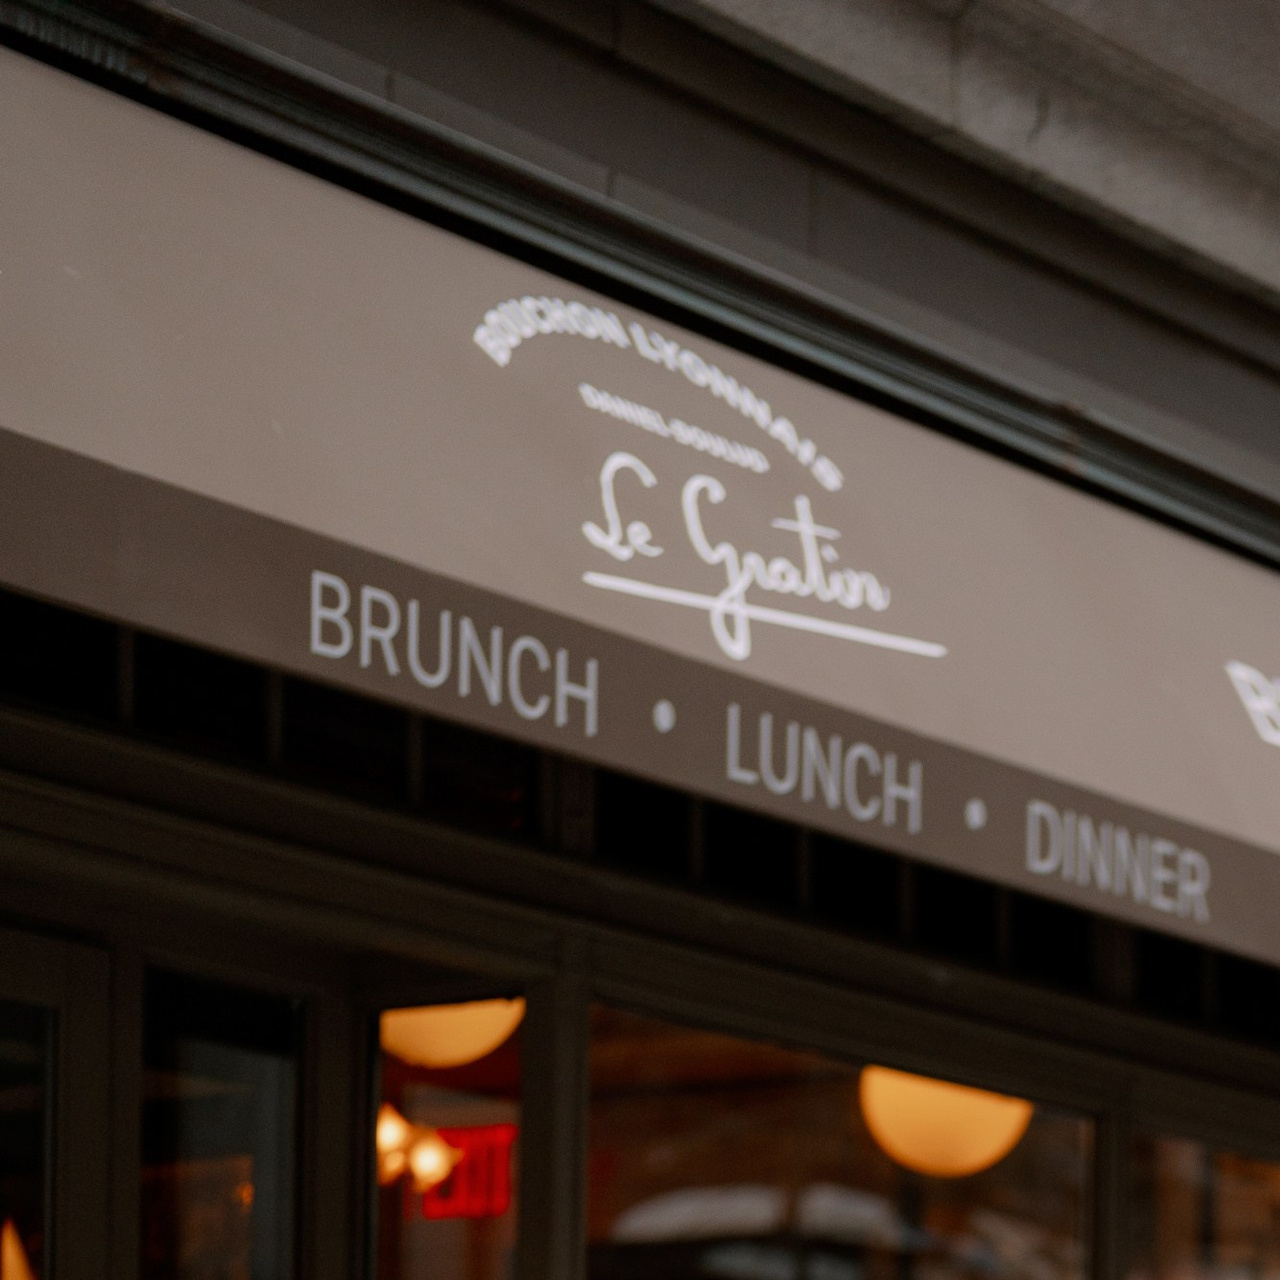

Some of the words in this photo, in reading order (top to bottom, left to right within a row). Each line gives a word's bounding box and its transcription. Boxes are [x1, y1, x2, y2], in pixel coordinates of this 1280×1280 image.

[582, 451, 662, 561] Le
[681, 474, 890, 661] Gratin
[310, 569, 600, 738] BRUNCH
[726, 701, 923, 836] LUNCH
[1025, 799, 1212, 925] DINNER
